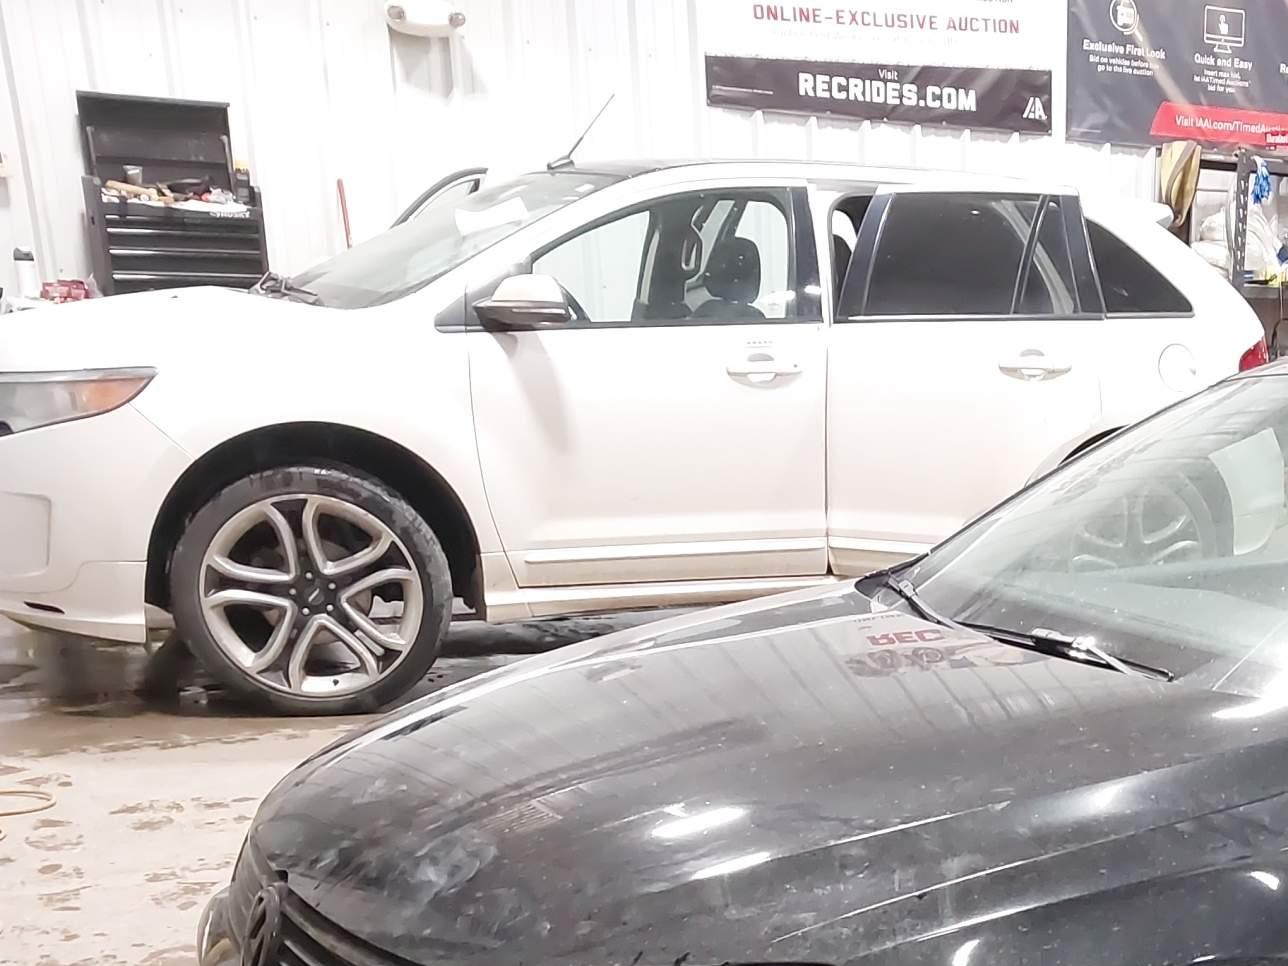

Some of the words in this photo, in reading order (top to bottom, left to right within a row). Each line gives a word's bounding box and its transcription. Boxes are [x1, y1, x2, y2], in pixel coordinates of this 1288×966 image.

[752, 4, 939, 31] ONLINE-EXCLUSIVE
[946, 16, 1020, 34] AUCTION
[1082, 39, 1124, 54] Exclusive
[1126, 44, 1145, 57] First
[1146, 47, 1166, 60] Look
[1194, 53, 1215, 66] Quick
[1217, 58, 1232, 68] and
[1234, 58, 1253, 71] Easy
[879, 69, 898, 80] Visit
[798, 72, 977, 112] RECRIDES.COM
[1175, 115, 1194, 126] Visit
